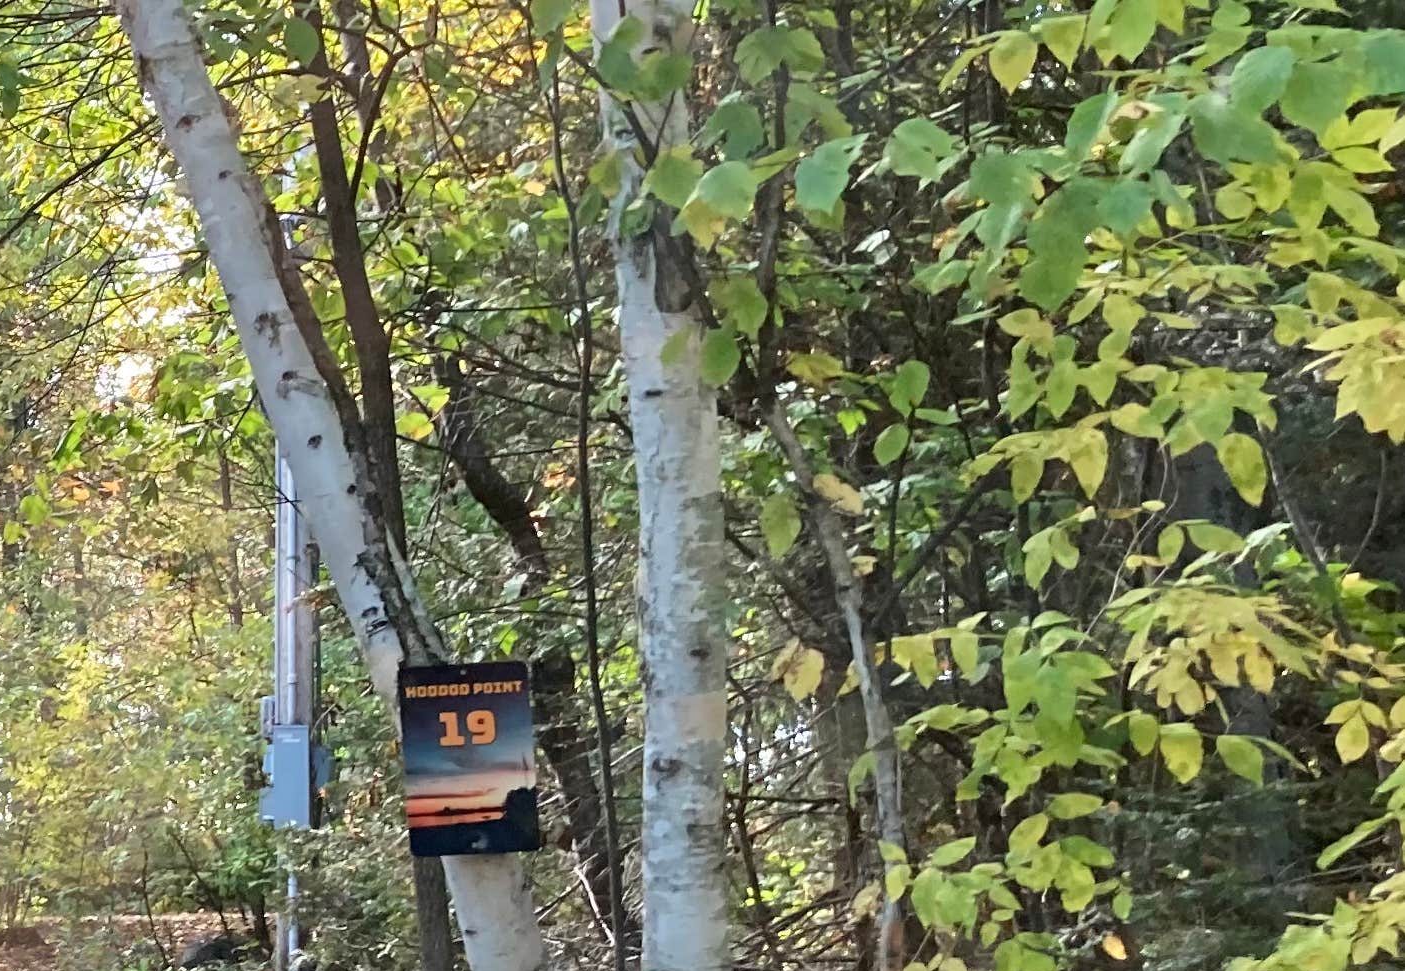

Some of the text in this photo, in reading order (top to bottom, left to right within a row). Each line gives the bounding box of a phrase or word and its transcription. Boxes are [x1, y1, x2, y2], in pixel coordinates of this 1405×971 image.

[405, 681, 522, 698] HOODOO POINT
[439, 710, 496, 746] 19
